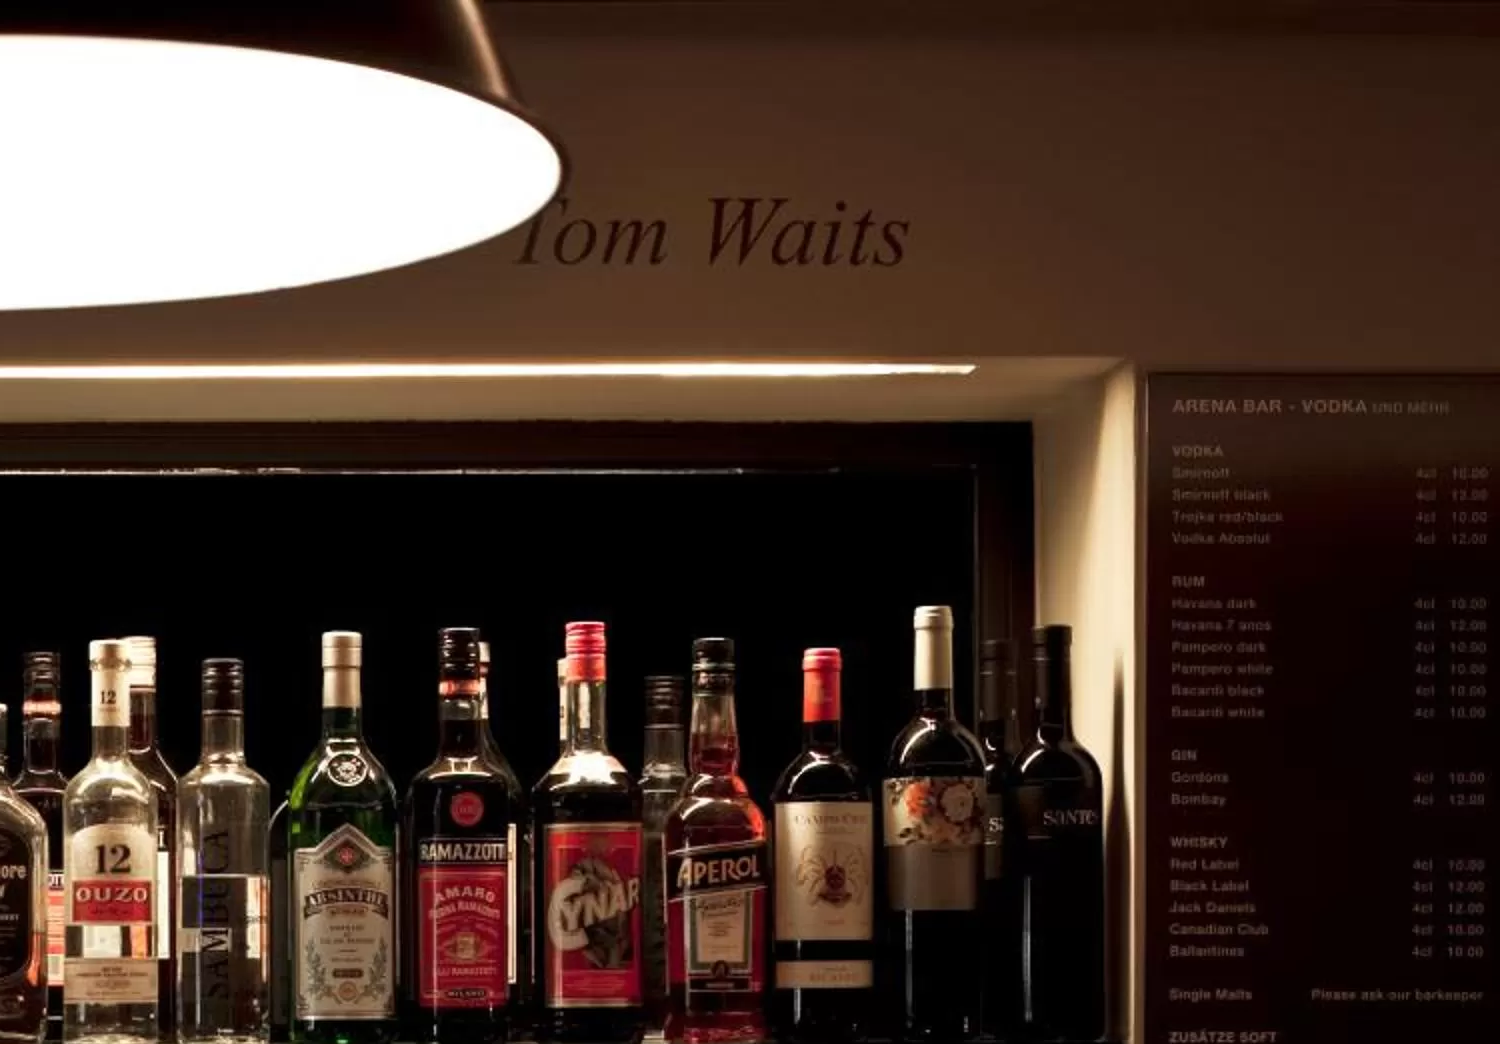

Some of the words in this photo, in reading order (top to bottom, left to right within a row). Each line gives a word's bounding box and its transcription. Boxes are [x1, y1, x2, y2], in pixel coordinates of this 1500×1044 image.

[707, 197, 911, 268] Waits
[1172, 400, 1236, 413] ARENA
[1243, 400, 1282, 413] BAR
[1301, 400, 1367, 413] VODKA
[1172, 446, 1224, 456] VODKA
[100, 690, 117, 705] 12
[1171, 750, 1198, 761] GIN
[1170, 837, 1228, 848] WHISKY
[94, 844, 132, 874] 12
[677, 854, 761, 889] APEROL
[75, 887, 148, 902] OUZO
[435, 885, 496, 903] AMARO
[548, 874, 640, 951] CYNAR
[1240, 1031, 1277, 1043] SOFT
